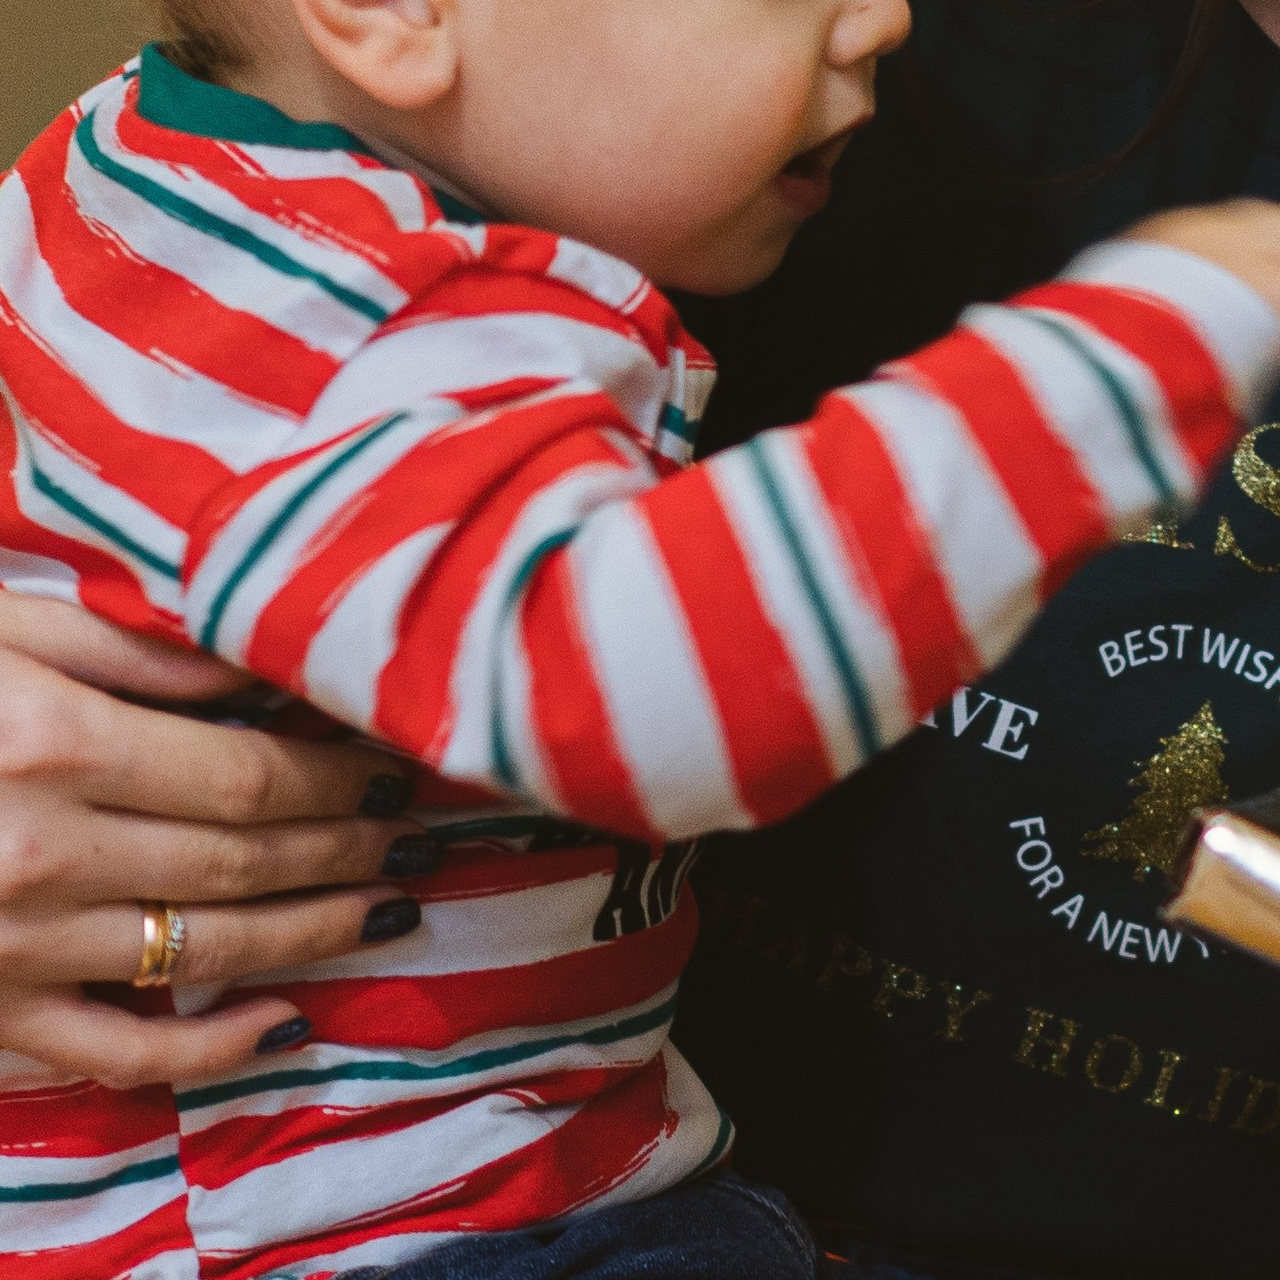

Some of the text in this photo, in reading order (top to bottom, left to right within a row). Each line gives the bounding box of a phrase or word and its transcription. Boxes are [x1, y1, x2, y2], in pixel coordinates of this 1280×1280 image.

[1098, 623, 1195, 679] BEST
[921, 685, 1041, 762] VE
[1009, 815, 1066, 901] FOR
[1050, 893, 1086, 931] A
[1086, 909, 1183, 965] NEW
